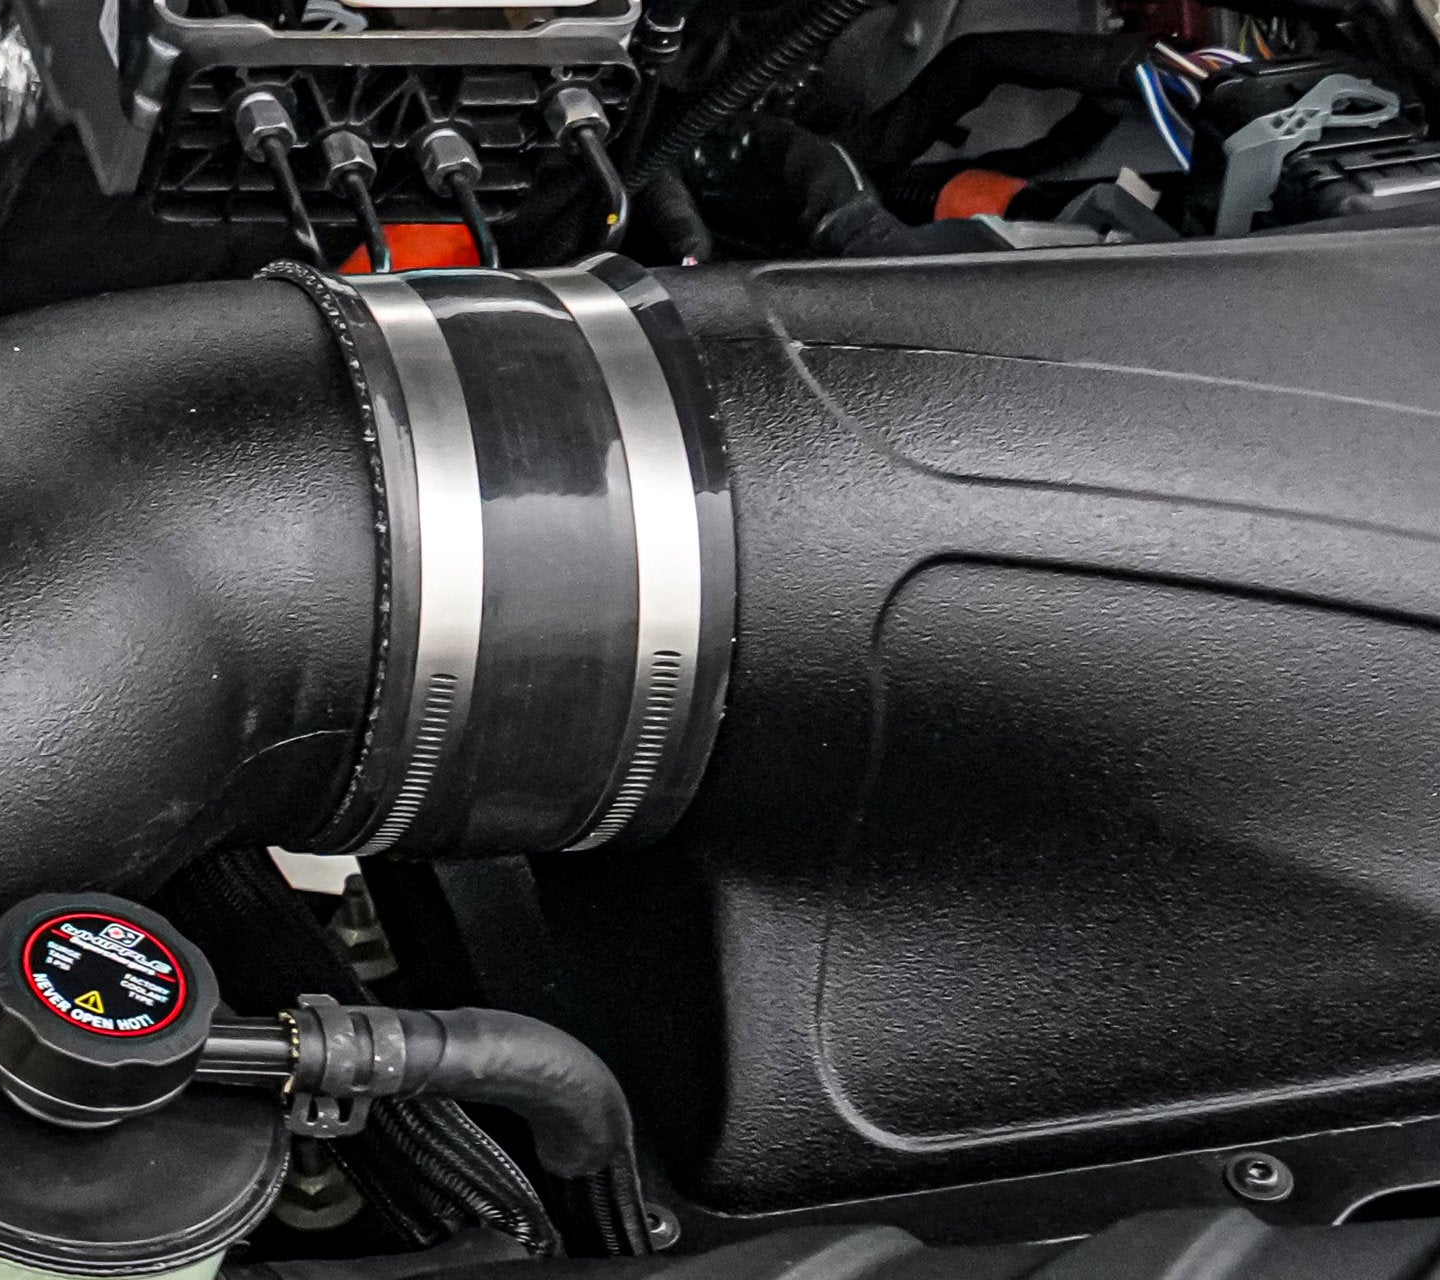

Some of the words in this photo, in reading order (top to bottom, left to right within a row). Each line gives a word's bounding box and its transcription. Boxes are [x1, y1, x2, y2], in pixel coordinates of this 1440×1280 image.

[33, 973, 72, 1012] NEVER
[71, 1008, 114, 1029] OPEN
[117, 1014, 154, 1030] HOT!
